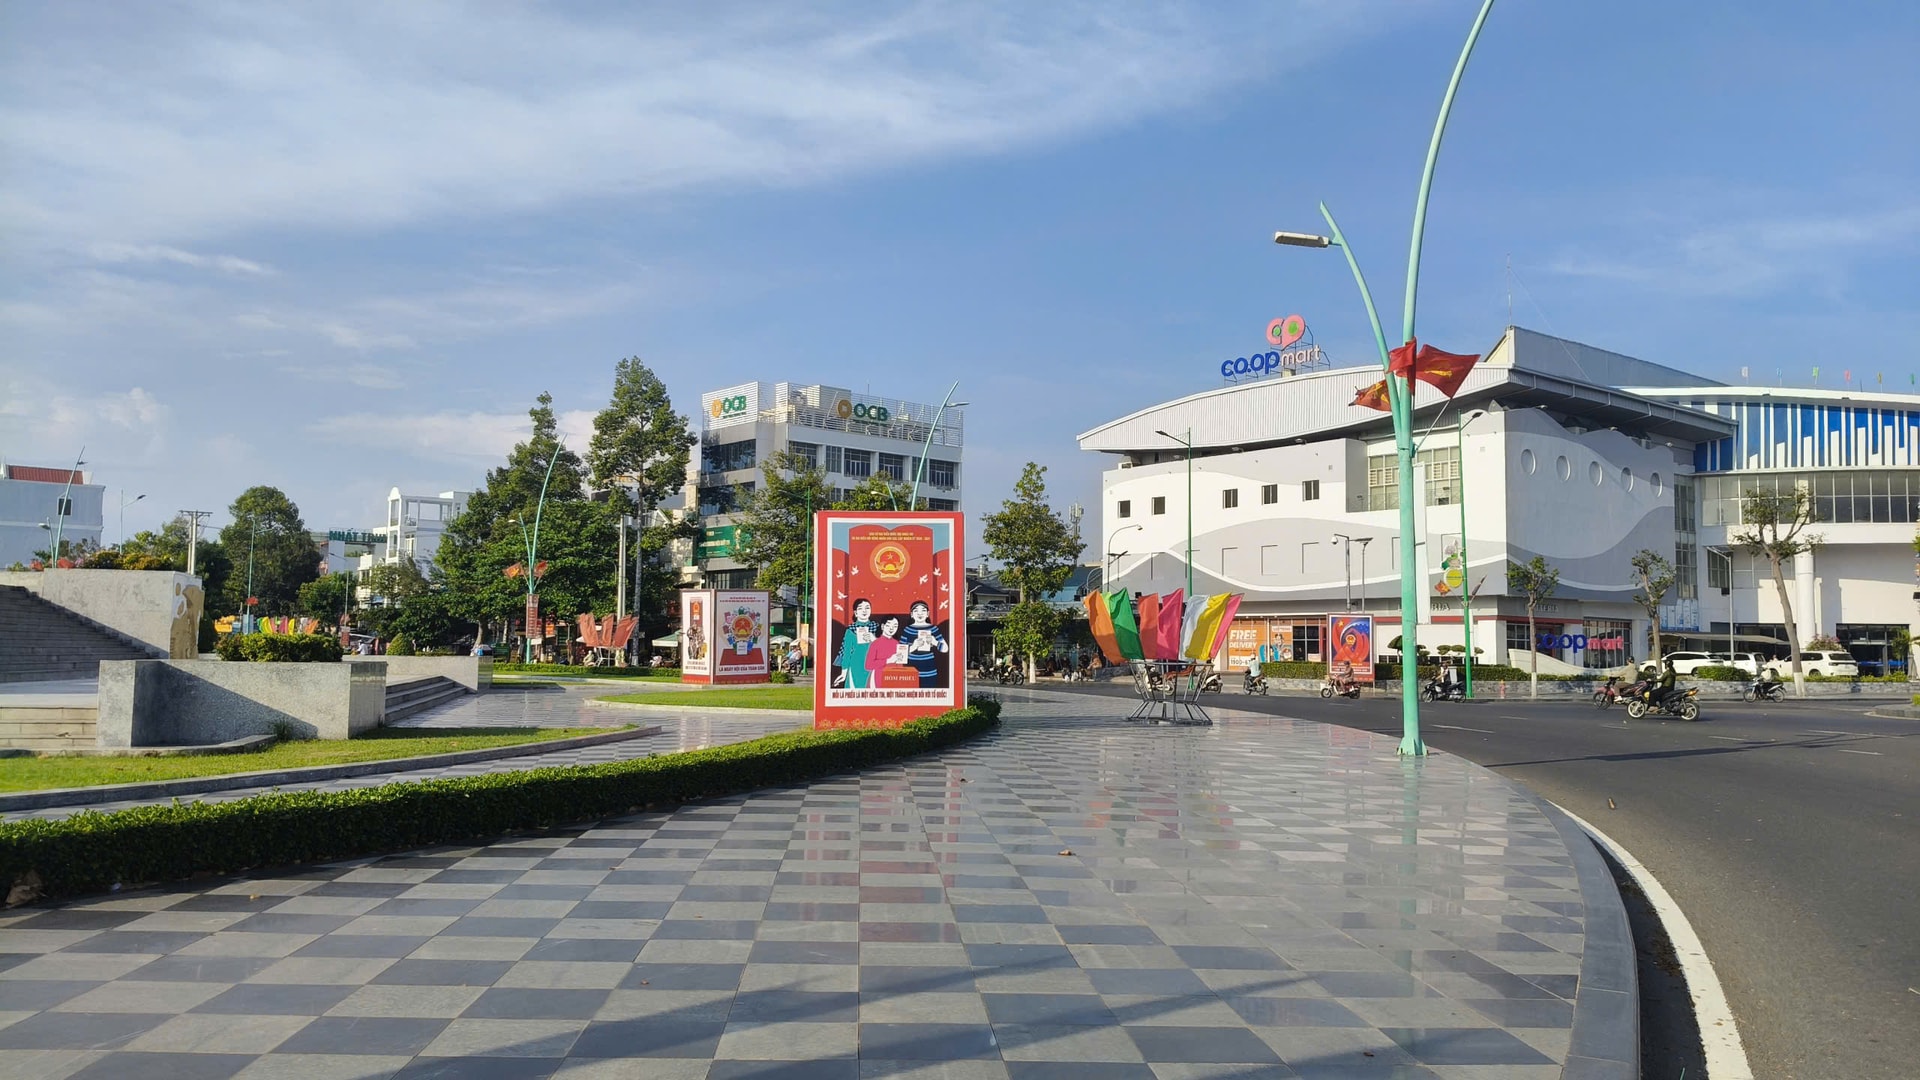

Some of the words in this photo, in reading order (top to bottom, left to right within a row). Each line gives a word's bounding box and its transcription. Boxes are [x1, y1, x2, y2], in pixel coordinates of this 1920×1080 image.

[723, 395, 746, 413] OCB
[854, 403, 887, 421] OCB
[1230, 630, 1257, 640] FREE
[1229, 641, 1257, 649] DELIVERY
